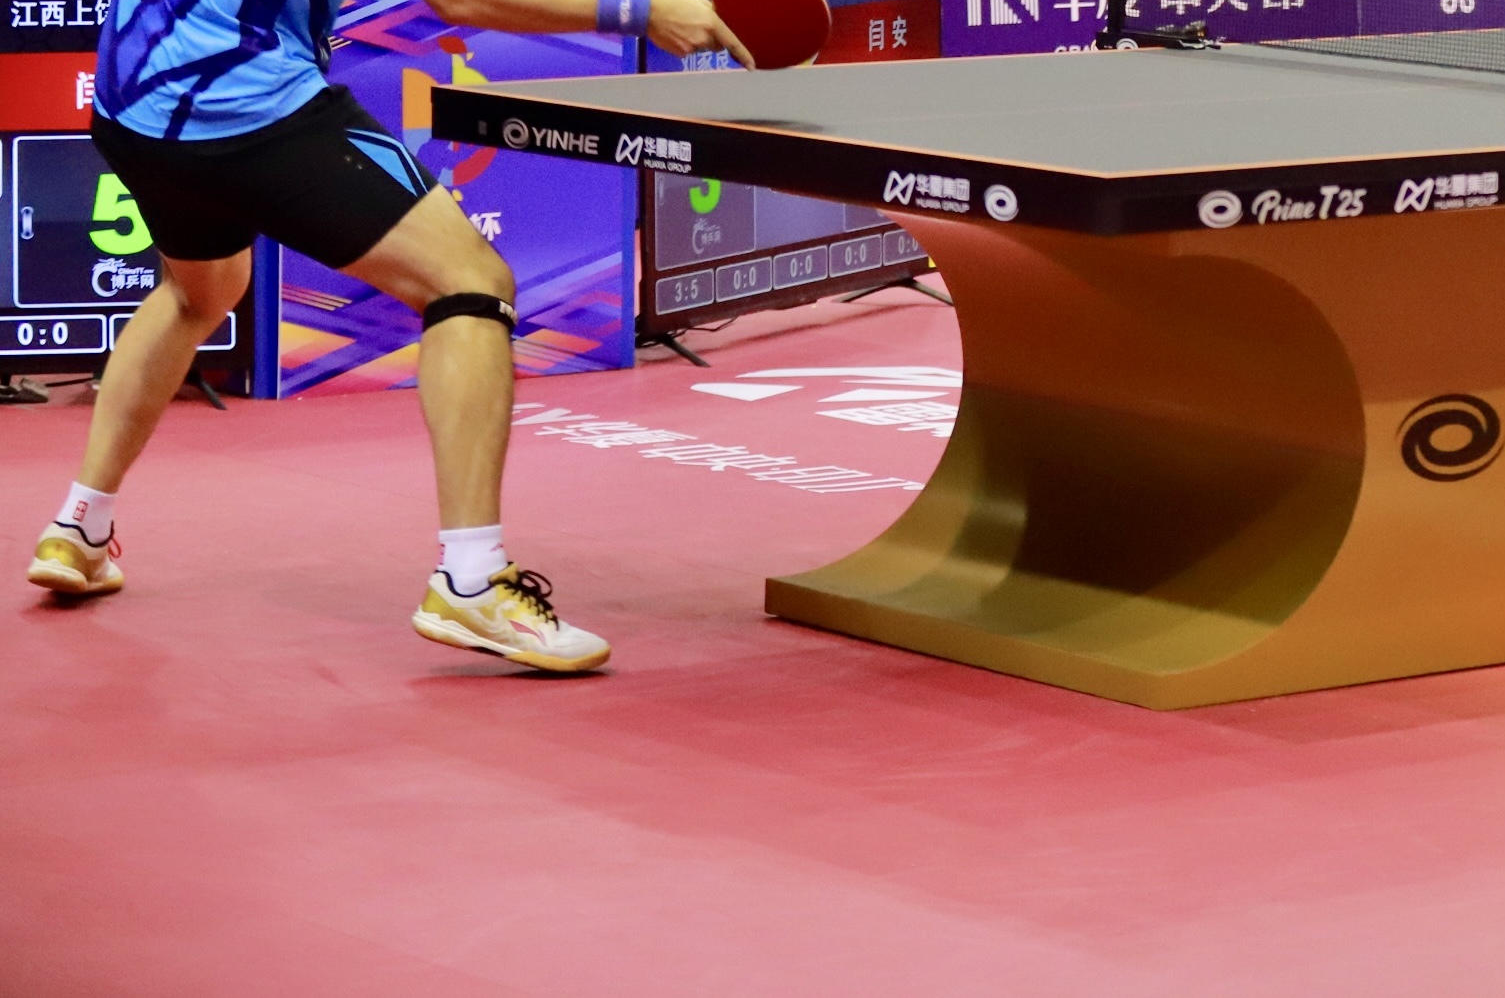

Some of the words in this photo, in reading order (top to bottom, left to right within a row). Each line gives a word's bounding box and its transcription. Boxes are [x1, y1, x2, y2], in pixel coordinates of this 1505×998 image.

[532, 126, 600, 155] YINHE
[644, 135, 692, 163] 华夏集团
[916, 173, 971, 202] 华夏集团
[1434, 170, 1499, 198] 华夏集团
[89, 172, 154, 255] 5
[1251, 188, 1315, 225] Prime
[674, 278, 699, 303] 3:5
[733, 266, 757, 290] 0:0
[790, 254, 813, 278] 0:0
[844, 243, 867, 266] 0:0
[17, 322, 69, 346] 0:0
